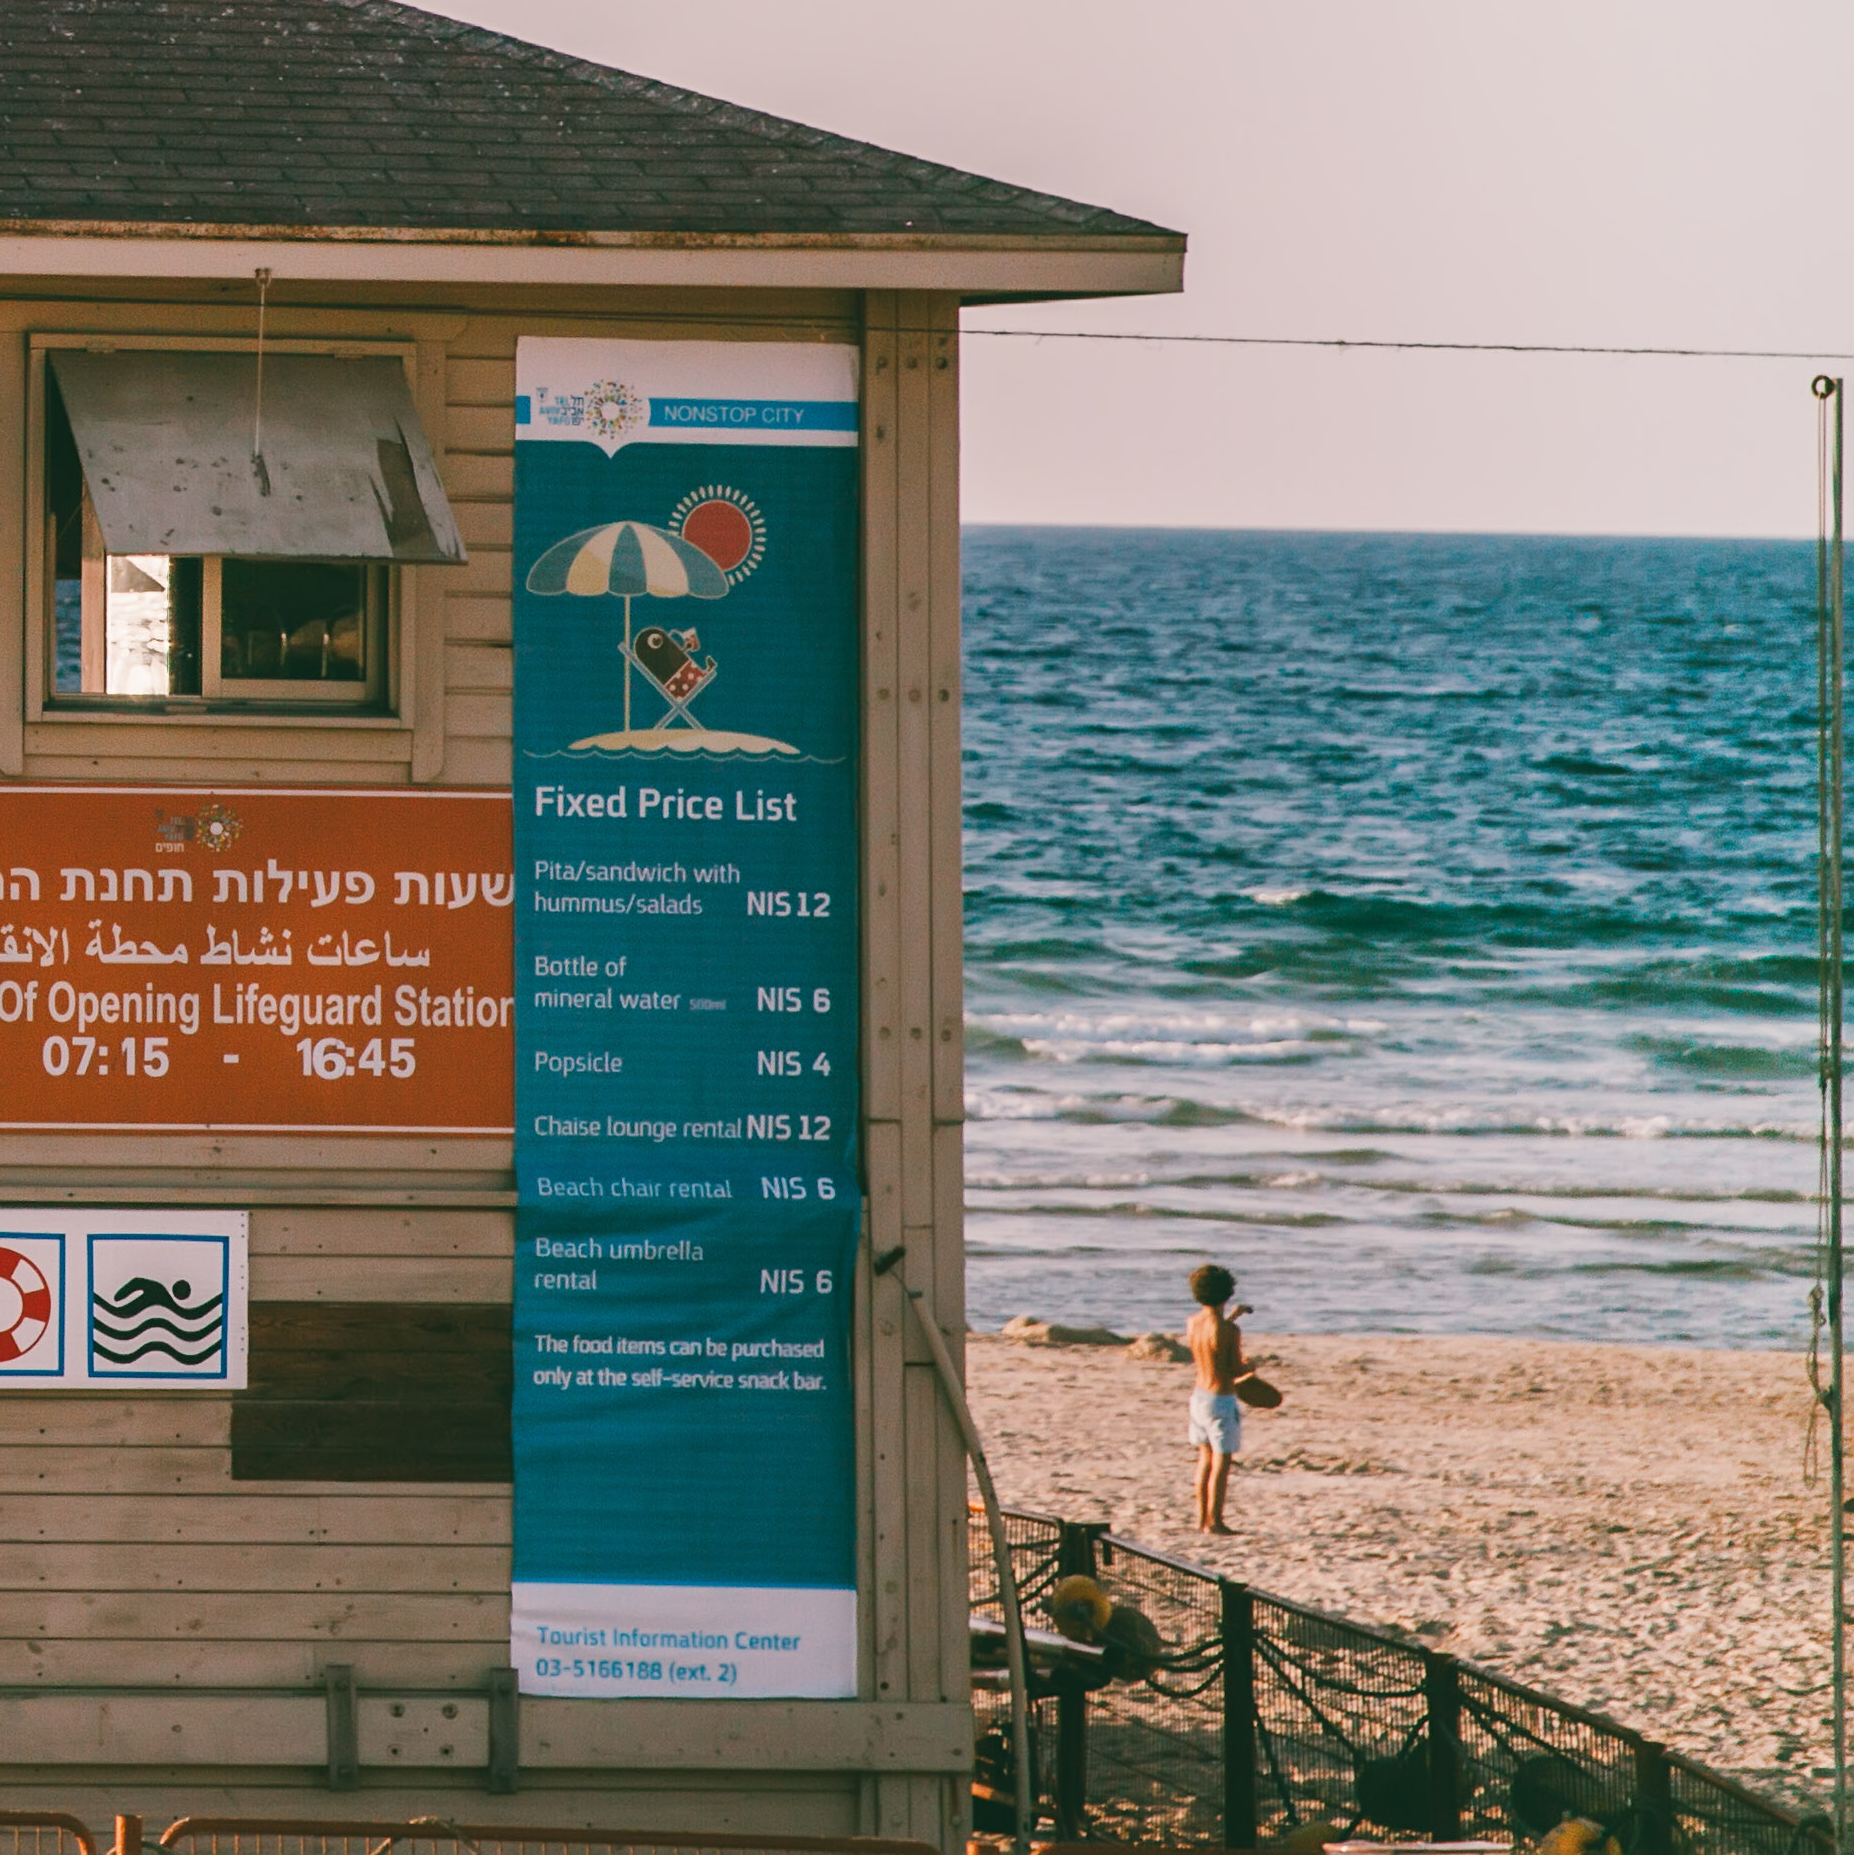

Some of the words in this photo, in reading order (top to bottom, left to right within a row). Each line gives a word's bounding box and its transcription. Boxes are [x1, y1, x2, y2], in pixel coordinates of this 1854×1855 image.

[665, 405, 756, 422] NONSTOP
[762, 408, 803, 423] CITY
[536, 786, 627, 817] Fixed
[639, 788, 723, 819] Price
[736, 790, 796, 821] List
[60, 868, 192, 902] תחנת
[213, 859, 375, 907] פעילות
[535, 861, 686, 882] Pita/sandwich
[693, 863, 740, 883] with
[393, 871, 514, 910] שעות
[535, 891, 702, 914] hummus/salads
[748, 891, 791, 916] NIS
[797, 892, 830, 917] 12
[85, 919, 188, 964] محطة
[200, 924, 292, 965] نشاط
[307, 931, 430, 966] ساعات
[535, 956, 598, 976] Bottle
[605, 956, 626, 977] of
[48, 980, 199, 1035] Opening
[213, 983, 382, 1036] Lifeguard
[535, 988, 612, 1008] mineral
[620, 992, 680, 1009] water
[758, 987, 801, 1012] NIS
[813, 988, 830, 1012] 6
[43, 1036, 169, 1077] 07:15
[223, 1054, 239, 1063] -
[297, 1038, 415, 1080] 16:45
[535, 1051, 622, 1077] Popsicle
[758, 1051, 801, 1076] NIS
[813, 1052, 830, 1076] 4
[535, 1115, 601, 1136] Chaise
[607, 1116, 677, 1142] lounge
[683, 1118, 741, 1138] rental
[747, 1115, 791, 1140] NIS
[799, 1115, 830, 1140] 12
[538, 1178, 603, 1196] Beach
[611, 1178, 661, 1197] chair
[670, 1180, 732, 1198] rental
[761, 1177, 806, 1199] NIS
[818, 1178, 835, 1199] 6
[536, 1238, 602, 1258] Beach
[610, 1239, 703, 1260] umbrella
[534, 1270, 596, 1290] rental
[760, 1269, 804, 1294] NIS
[816, 1270, 832, 1293] 6
[535, 1335, 568, 1353] The
[573, 1335, 613, 1353] food
[617, 1338, 666, 1355] items
[669, 1341, 702, 1355] can
[706, 1337, 727, 1356] be
[732, 1339, 824, 1361] purchased
[533, 1366, 572, 1390] only
[576, 1369, 593, 1385] at
[597, 1368, 627, 1386] the
[631, 1368, 734, 1388] self-service
[738, 1371, 789, 1389] snack
[793, 1371, 826, 1390] bar.
[538, 1627, 606, 1646] Tourist
[614, 1628, 728, 1649] Information
[735, 1632, 800, 1650] Center
[536, 1659, 662, 1680] 03-5166188
[669, 1663, 710, 1681] (ext.
[718, 1664, 737, 1685] 2)
